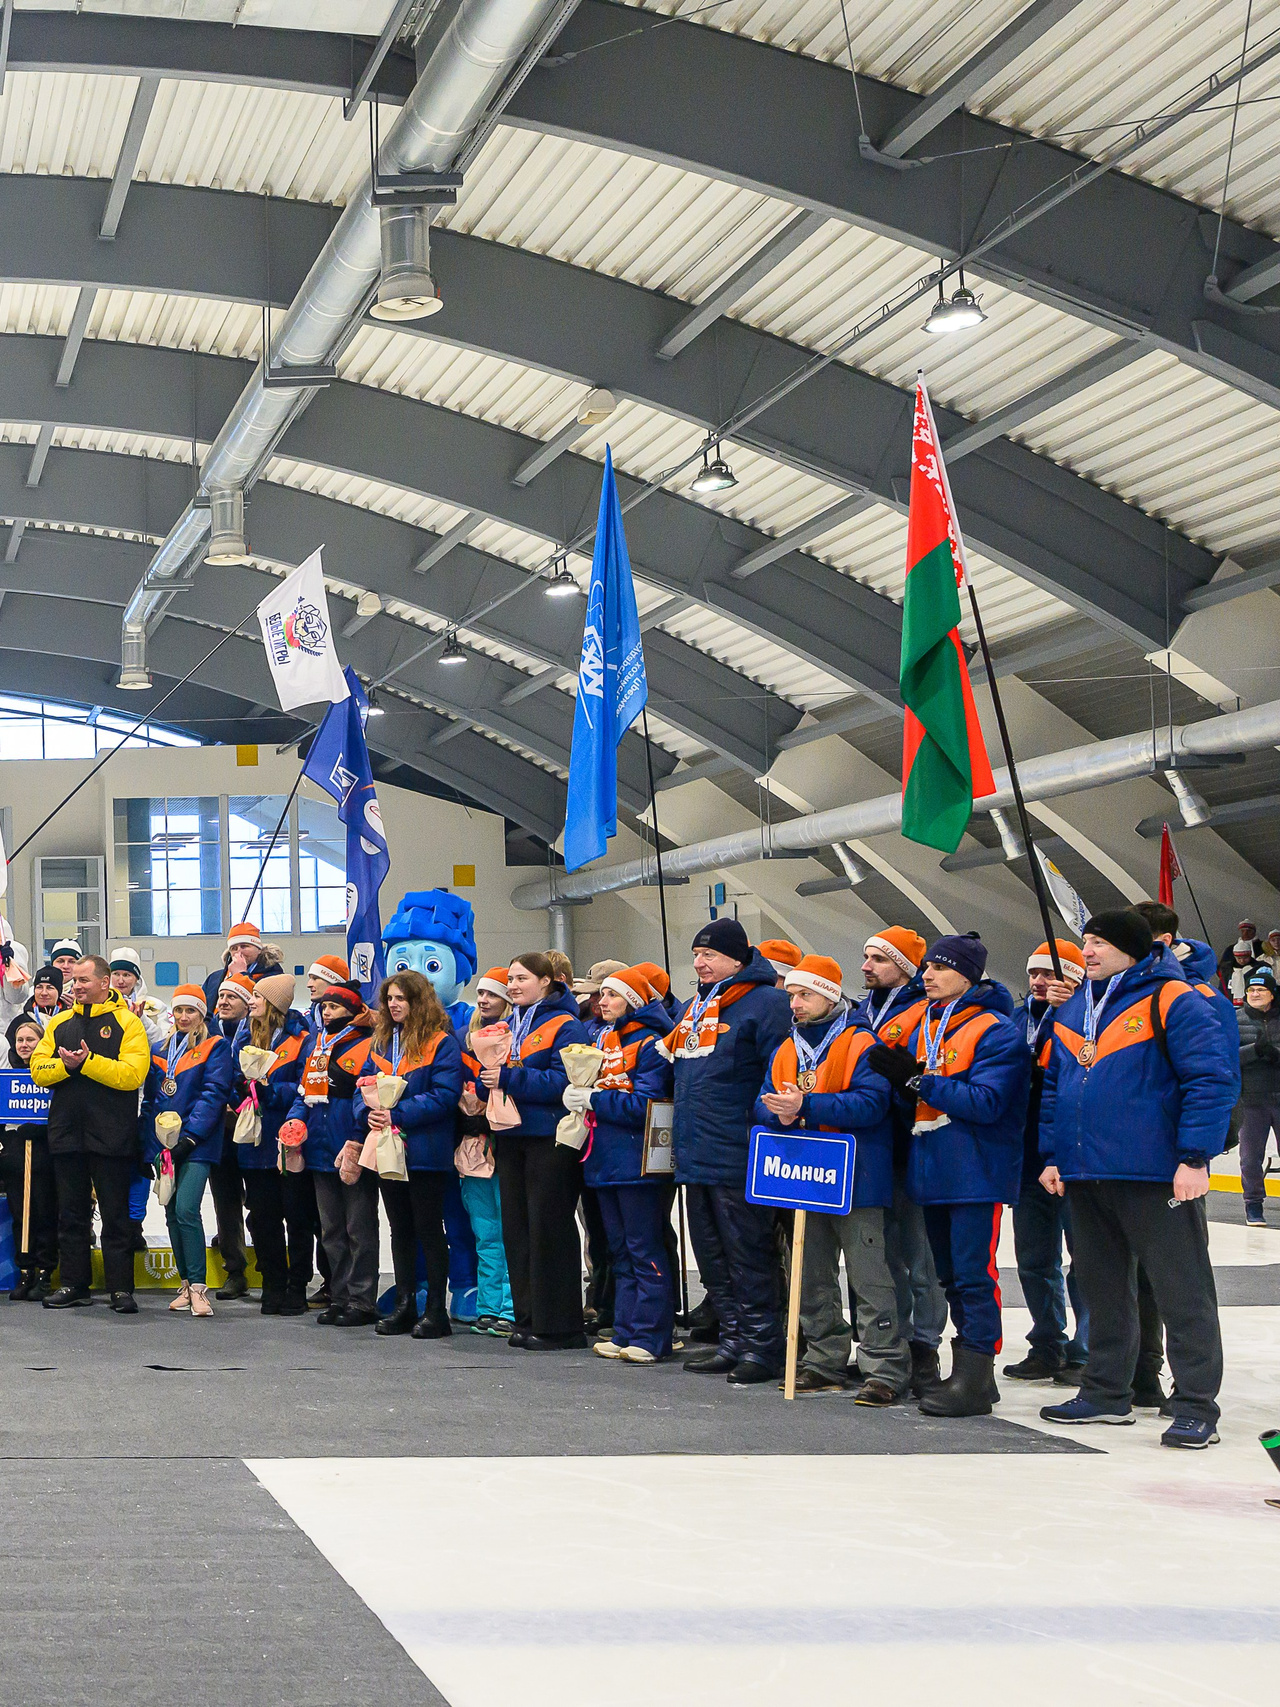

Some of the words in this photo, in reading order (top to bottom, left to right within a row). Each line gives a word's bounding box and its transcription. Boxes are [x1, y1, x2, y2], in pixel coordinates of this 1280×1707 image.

[11, 1080, 50, 1094] Белые
[8, 1098, 51, 1114] тигры
[763, 1155, 837, 1185] Молния
